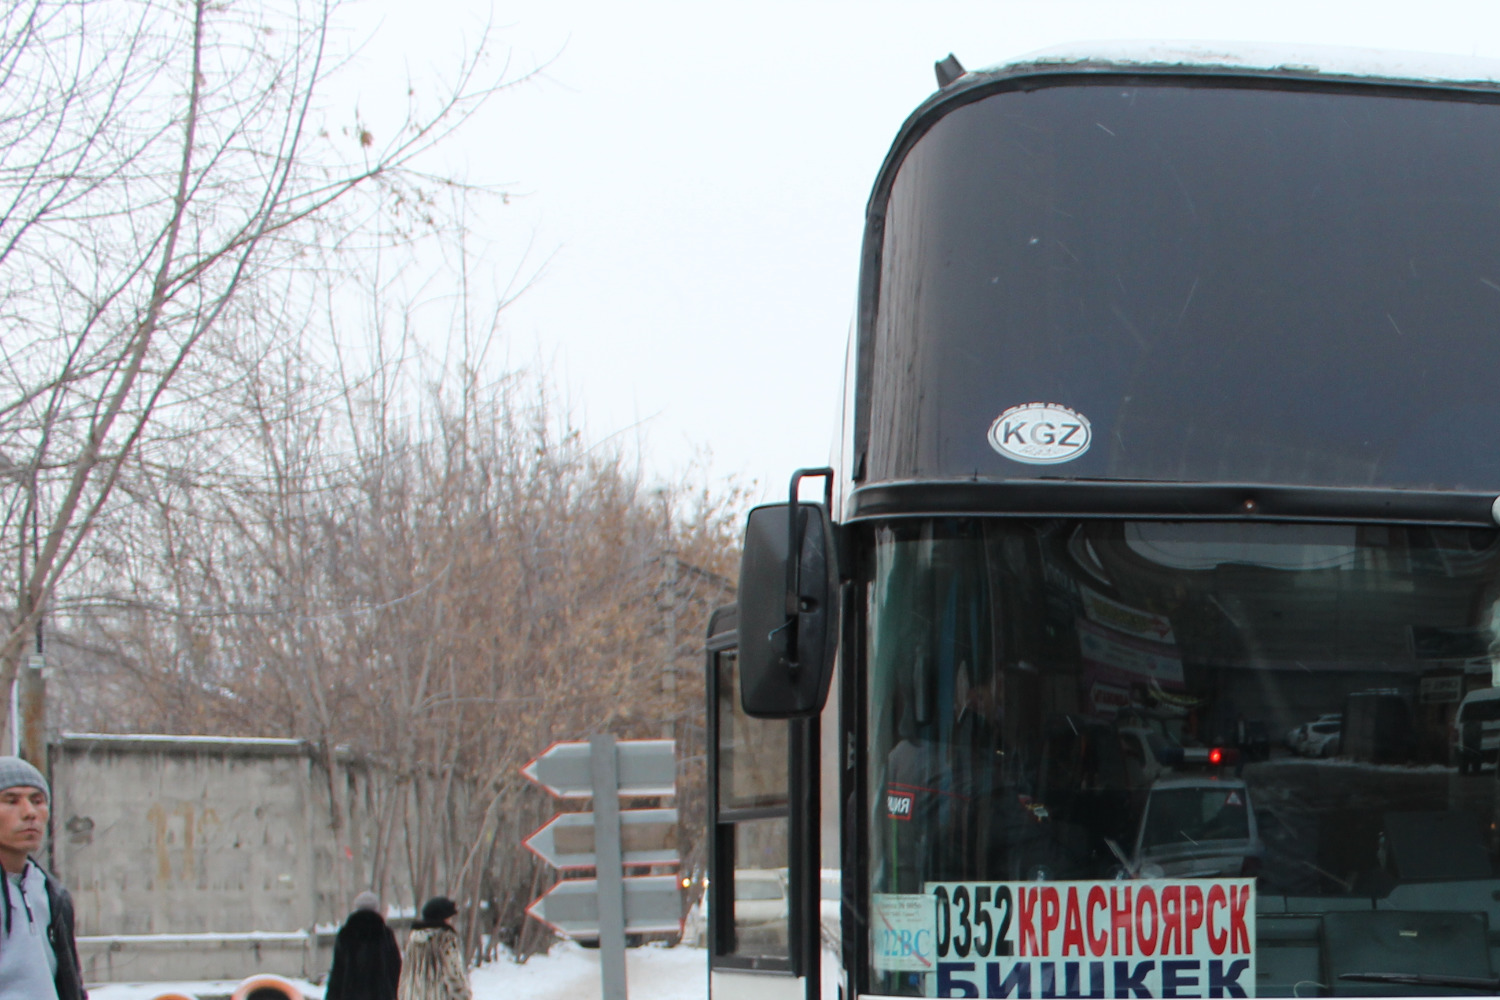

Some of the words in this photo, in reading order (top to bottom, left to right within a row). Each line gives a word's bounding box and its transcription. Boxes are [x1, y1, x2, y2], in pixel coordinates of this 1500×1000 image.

[1003, 421, 1081, 447] KGZ
[934, 885, 1014, 957] 0352
[1018, 884, 1251, 956] КРАСНОЯРСК
[936, 959, 1250, 999] БИШКЕК
